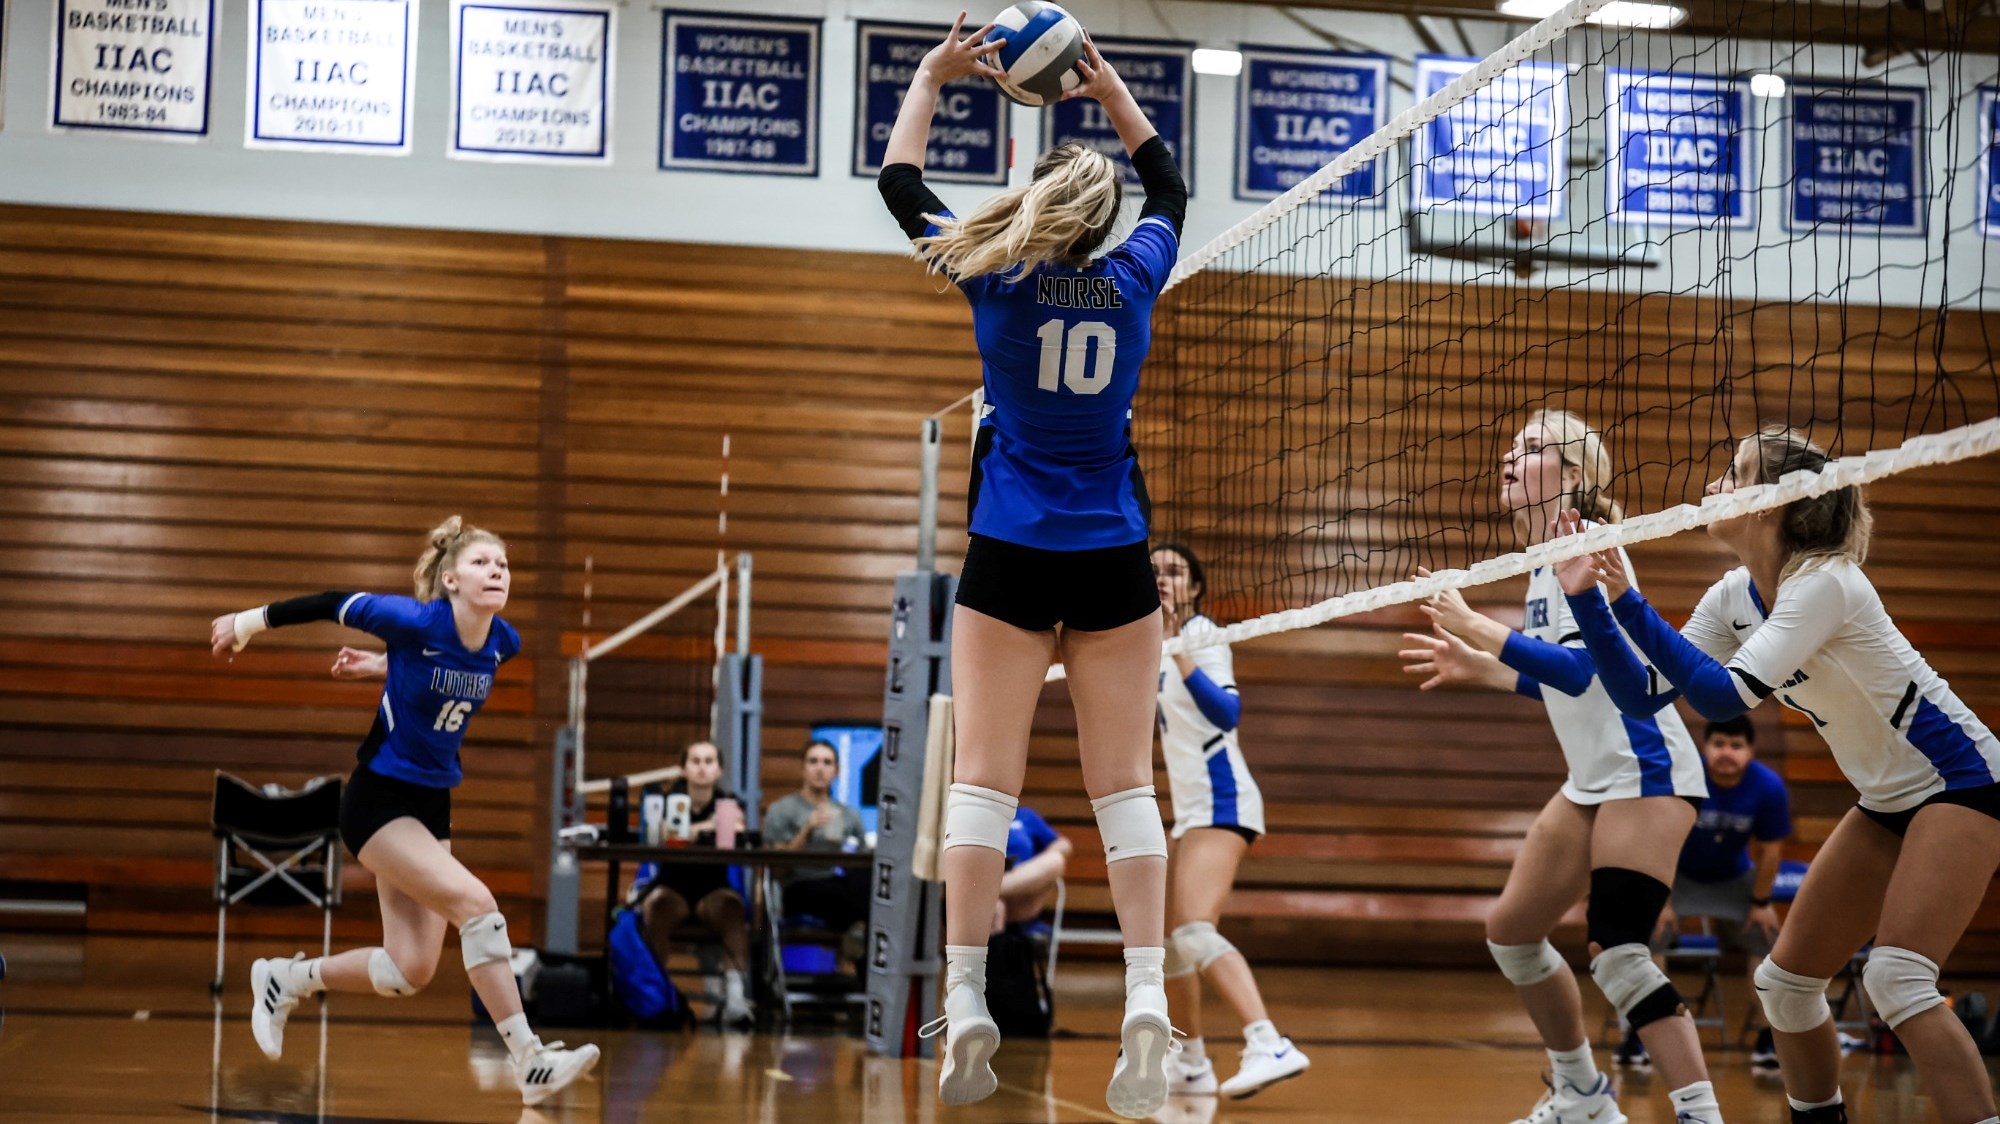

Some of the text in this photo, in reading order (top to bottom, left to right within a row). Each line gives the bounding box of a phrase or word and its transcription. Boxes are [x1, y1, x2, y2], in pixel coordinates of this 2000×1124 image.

[106, 0, 168, 12] MENS
[68, 10, 203, 37] BASKETBALL
[267, 25, 396, 46] BASKETBALL
[95, 44, 173, 74] IIAC
[470, 40, 598, 63] BASKETBALL
[295, 60, 369, 85] IIAC
[677, 54, 806, 79] BASKETBALL
[71, 78, 195, 104] CHAMPIONS
[496, 71, 569, 98] IIAC
[702, 80, 780, 111] IIAC
[270, 93, 391, 115] CHAMPIONS
[1251, 89, 1372, 114] BASKETBALL
[295, 115, 364, 134] 2010-11
[471, 105, 591, 127] CHAMPIONS
[679, 112, 801, 138] CHAMPIONS
[871, 122, 992, 147] CPIONS
[1275, 114, 1351, 145] IIAC
[1643, 136, 1719, 167] IIAC
[1818, 147, 1889, 176] IIAC
[1037, 274, 1122, 309] NORSE
[1036, 319, 1116, 394] 10
[431, 666, 492, 699] LUTHER
[433, 700, 473, 733] 16
